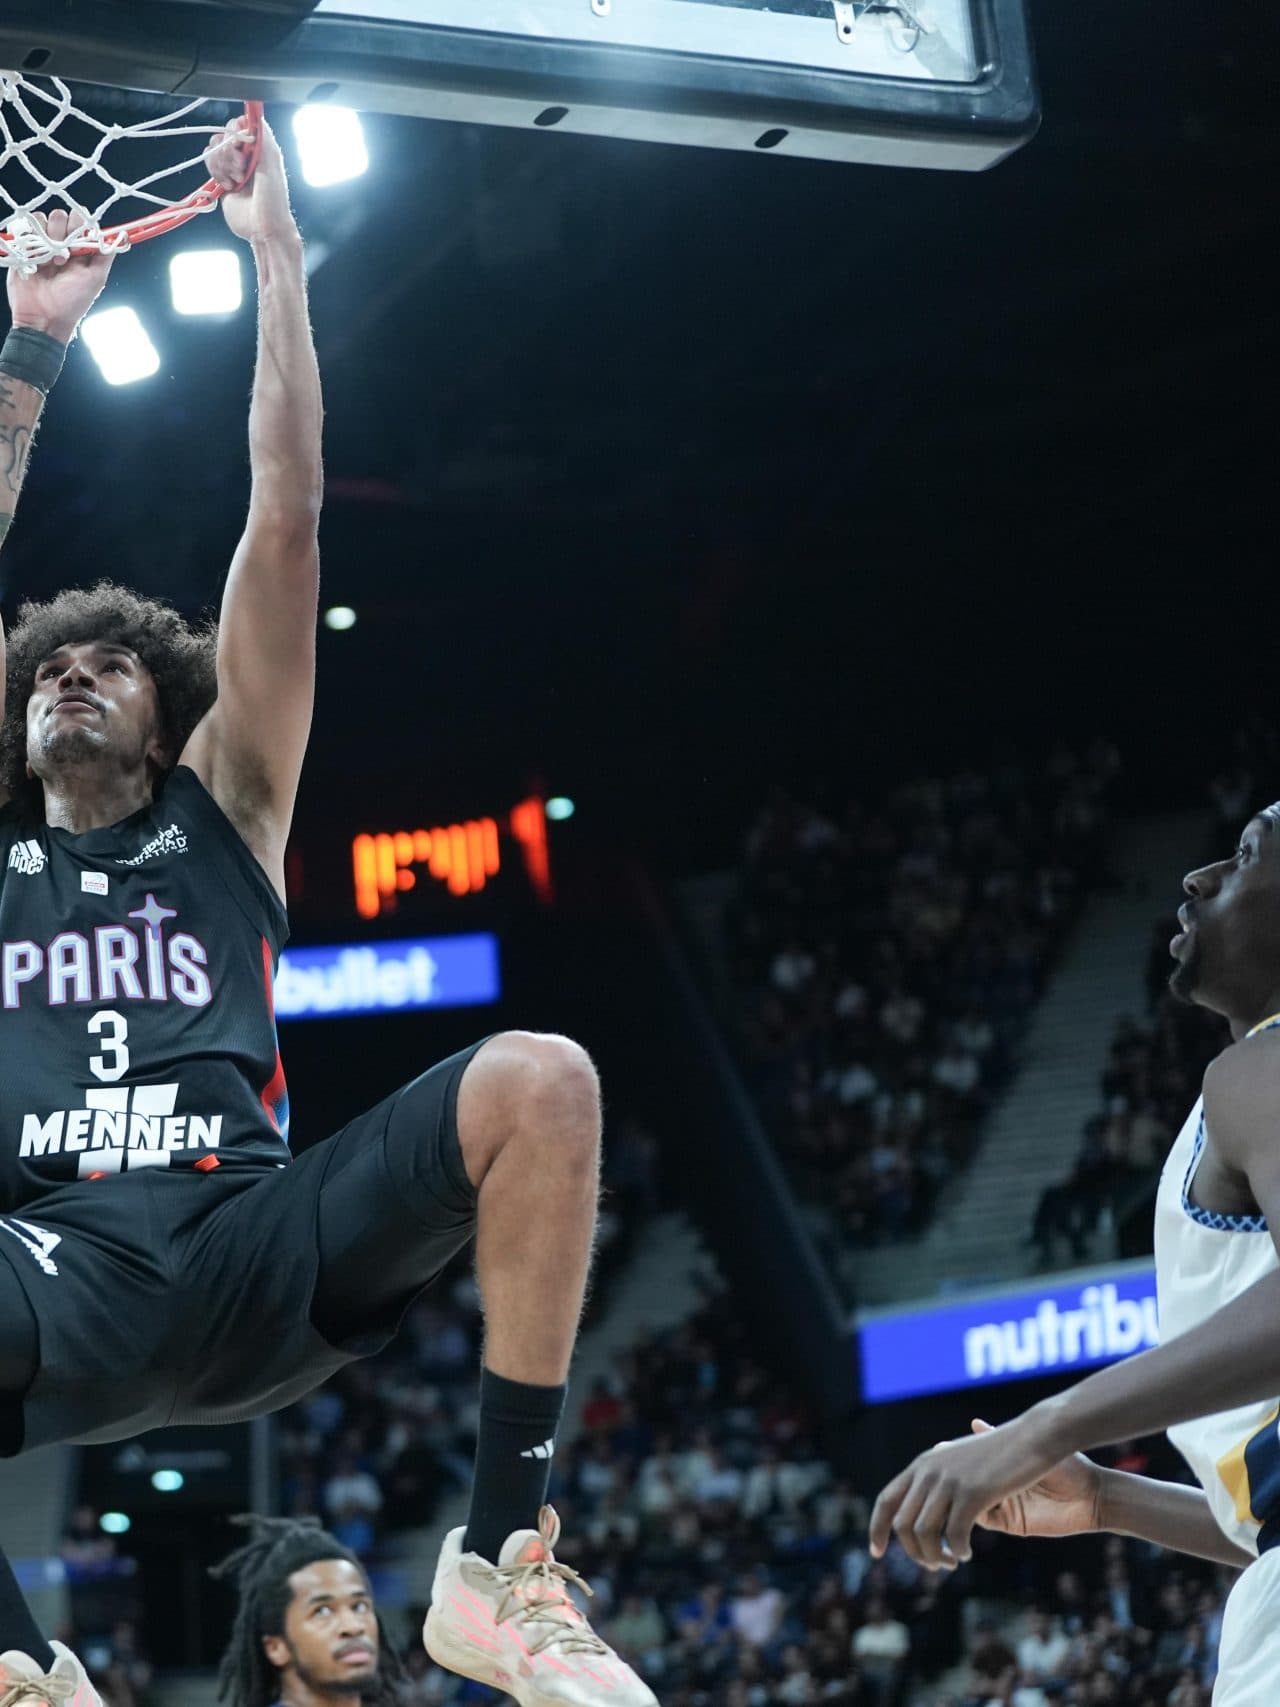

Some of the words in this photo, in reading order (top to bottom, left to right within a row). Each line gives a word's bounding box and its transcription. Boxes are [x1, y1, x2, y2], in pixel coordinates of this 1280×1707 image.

[2, 923, 212, 1009] PARIS
[87, 1009, 130, 1082] 3
[19, 1108, 222, 1157] MENNEN
